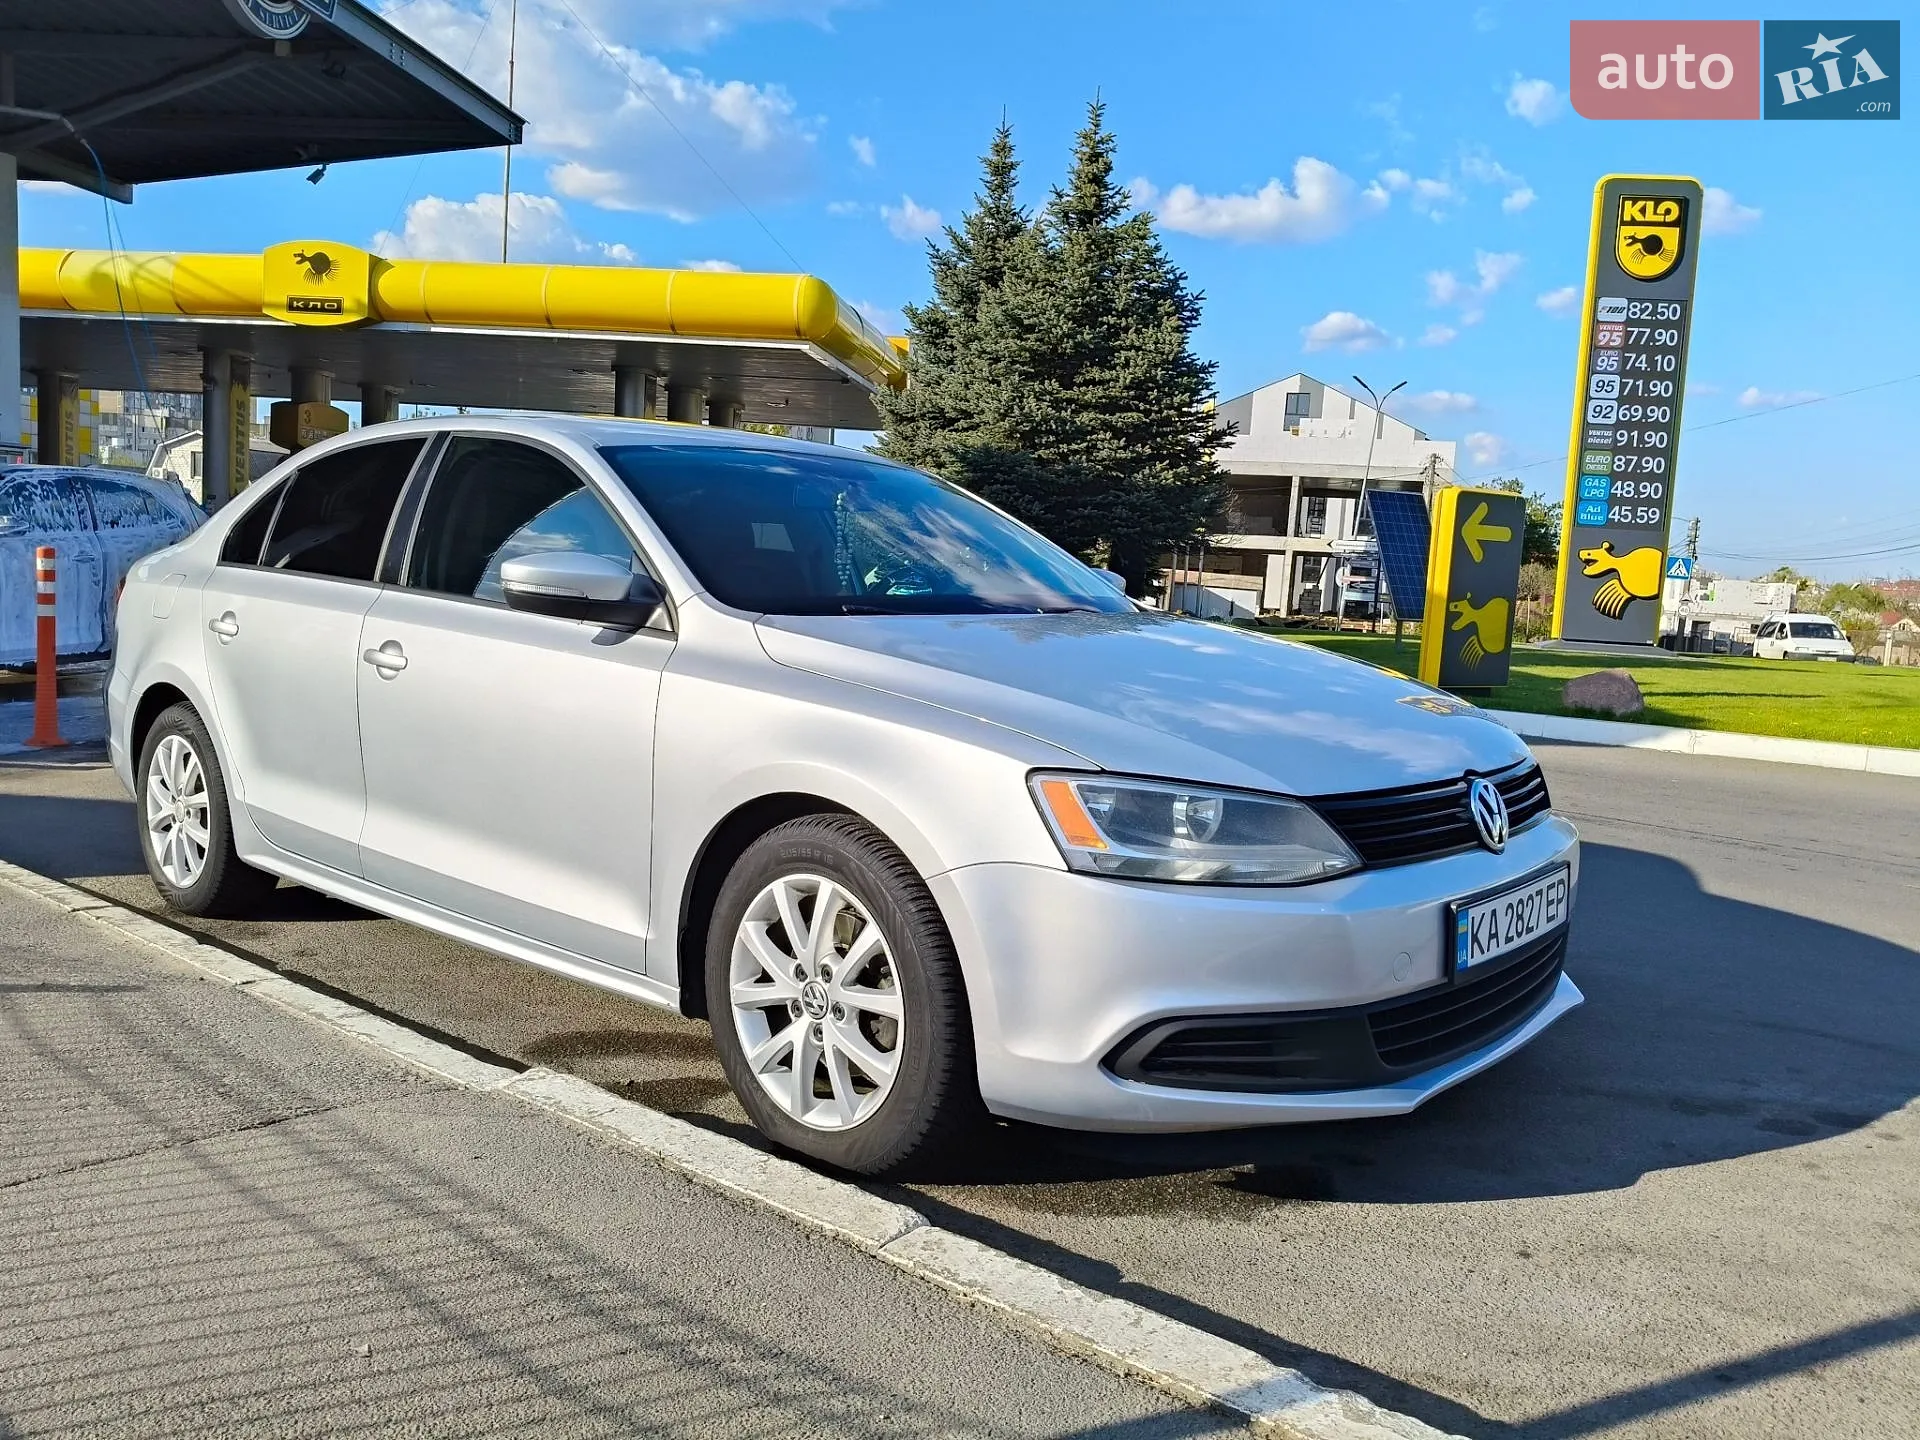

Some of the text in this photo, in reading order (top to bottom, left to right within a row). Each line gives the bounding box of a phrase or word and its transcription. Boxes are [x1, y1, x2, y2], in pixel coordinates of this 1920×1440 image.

[1623, 201, 1679, 222] KLO
[293, 300, 337, 309] КЛО
[1628, 302, 1681, 320] 82.50
[1598, 327, 1678, 346] 95 77.90
[1596, 353, 1675, 372] 95 74.10
[1595, 379, 1673, 397] 95 71.90
[304, 409, 312, 424] 3
[1591, 404, 1670, 422] 92 69.90
[235, 400, 246, 483] VENTUS
[1616, 429, 1668, 448] 91.90
[1585, 455, 1611, 463] EURO
[1613, 455, 1665, 474] 87.90
[1584, 478, 1607, 487] GAS
[1584, 480, 1663, 499] LPG 48.90
[1586, 505, 1601, 513] Ad
[1608, 505, 1660, 524] 45.59
[1471, 878, 1566, 959] KA 2827 EP
[1457, 950, 1467, 964] UA
